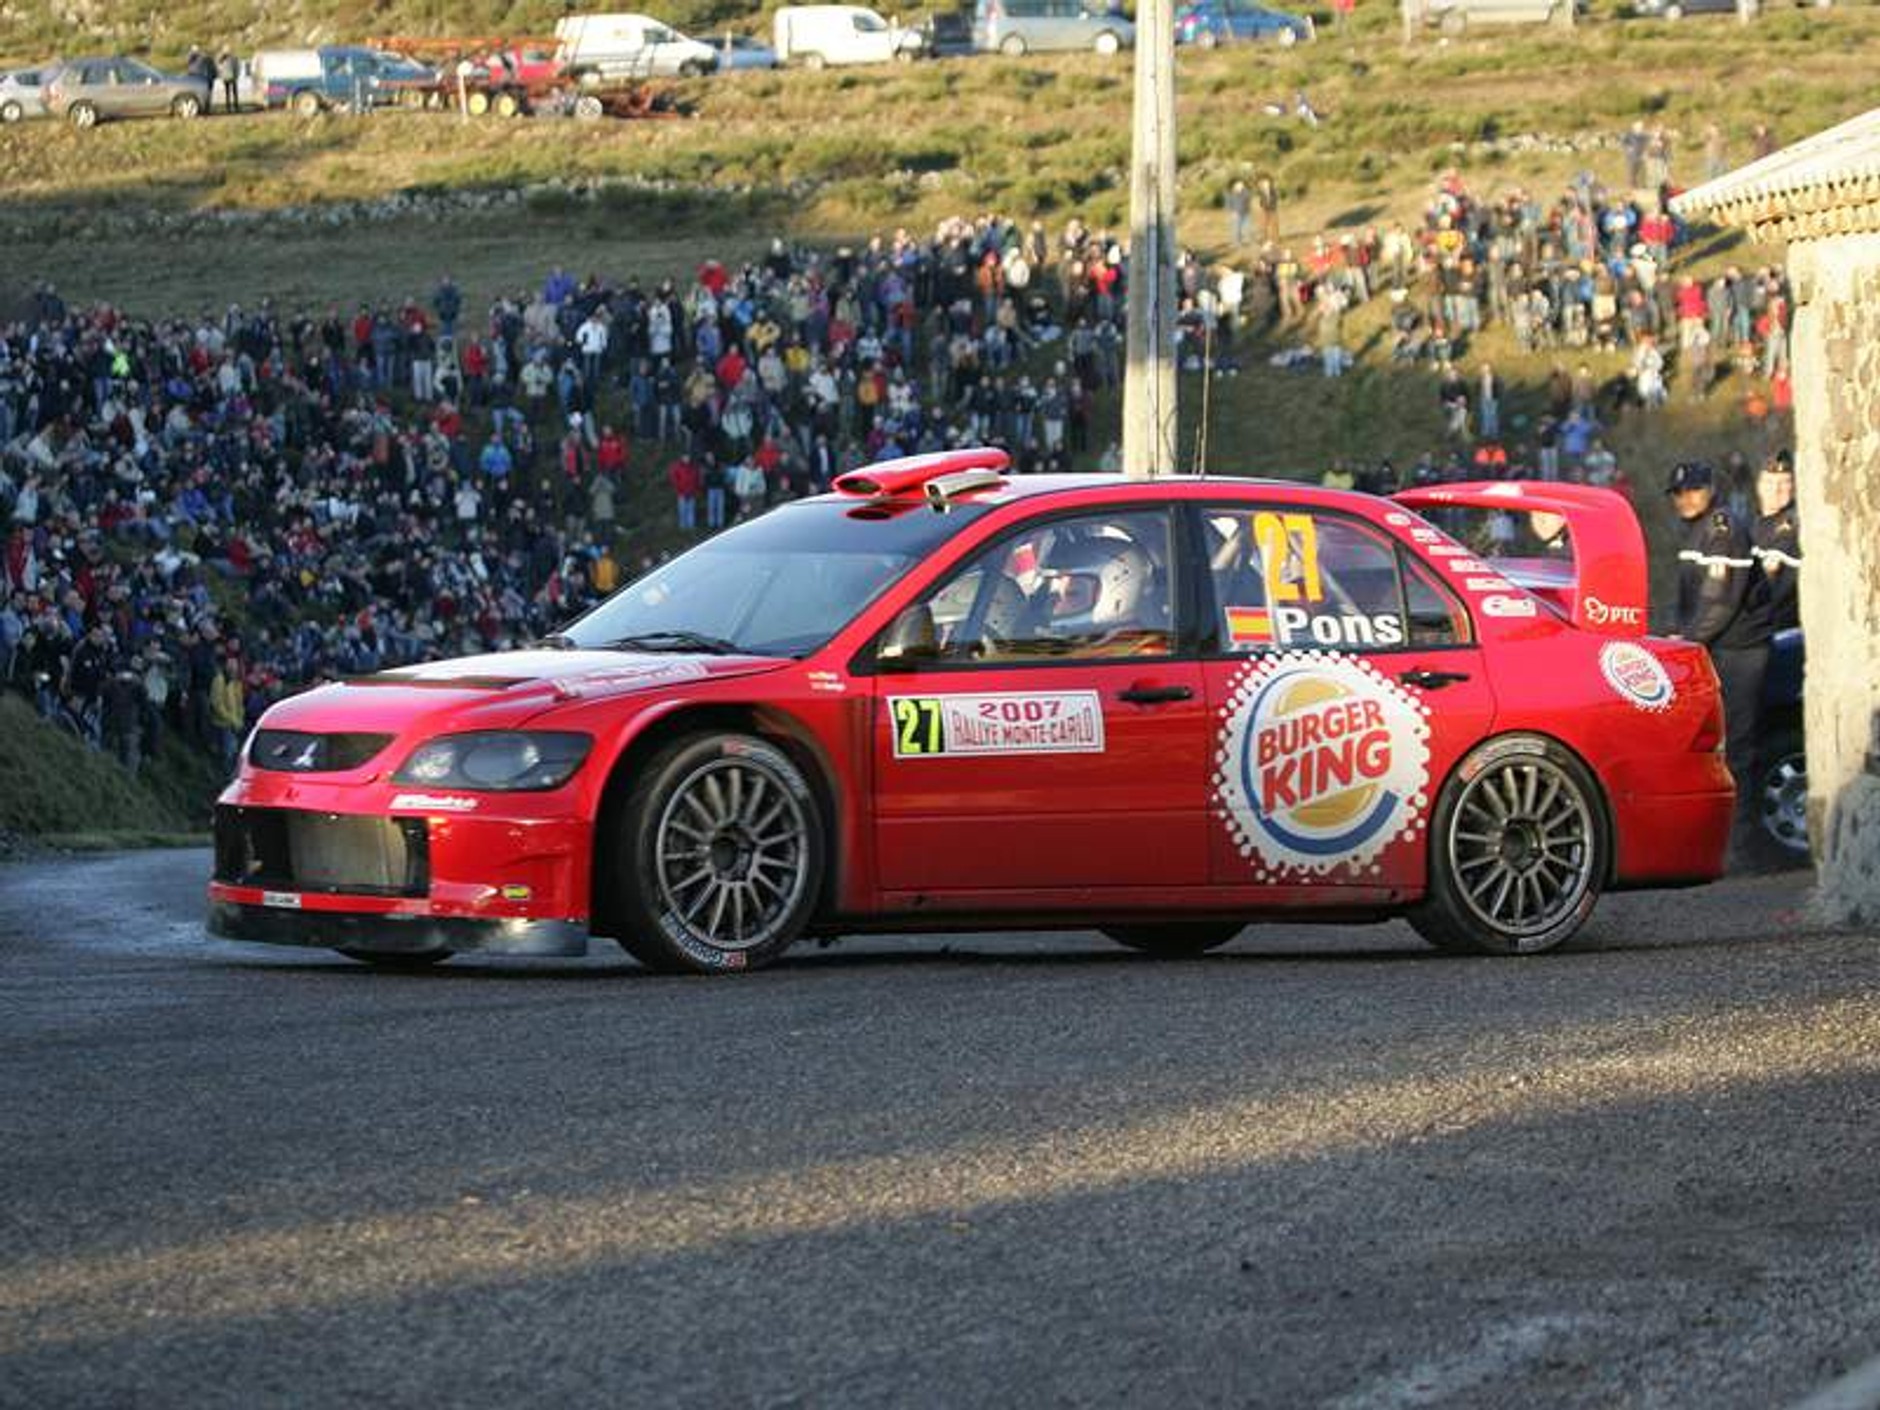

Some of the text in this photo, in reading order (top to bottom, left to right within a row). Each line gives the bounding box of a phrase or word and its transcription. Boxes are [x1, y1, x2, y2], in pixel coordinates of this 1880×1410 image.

[1254, 512, 1324, 602] 27
[1276, 607, 1403, 645] Pons
[897, 700, 942, 754] 27
[952, 709, 998, 746] RALLYE
[978, 701, 1061, 722] 2007
[1258, 700, 1385, 766] BURGER
[1262, 729, 1391, 815] KING
